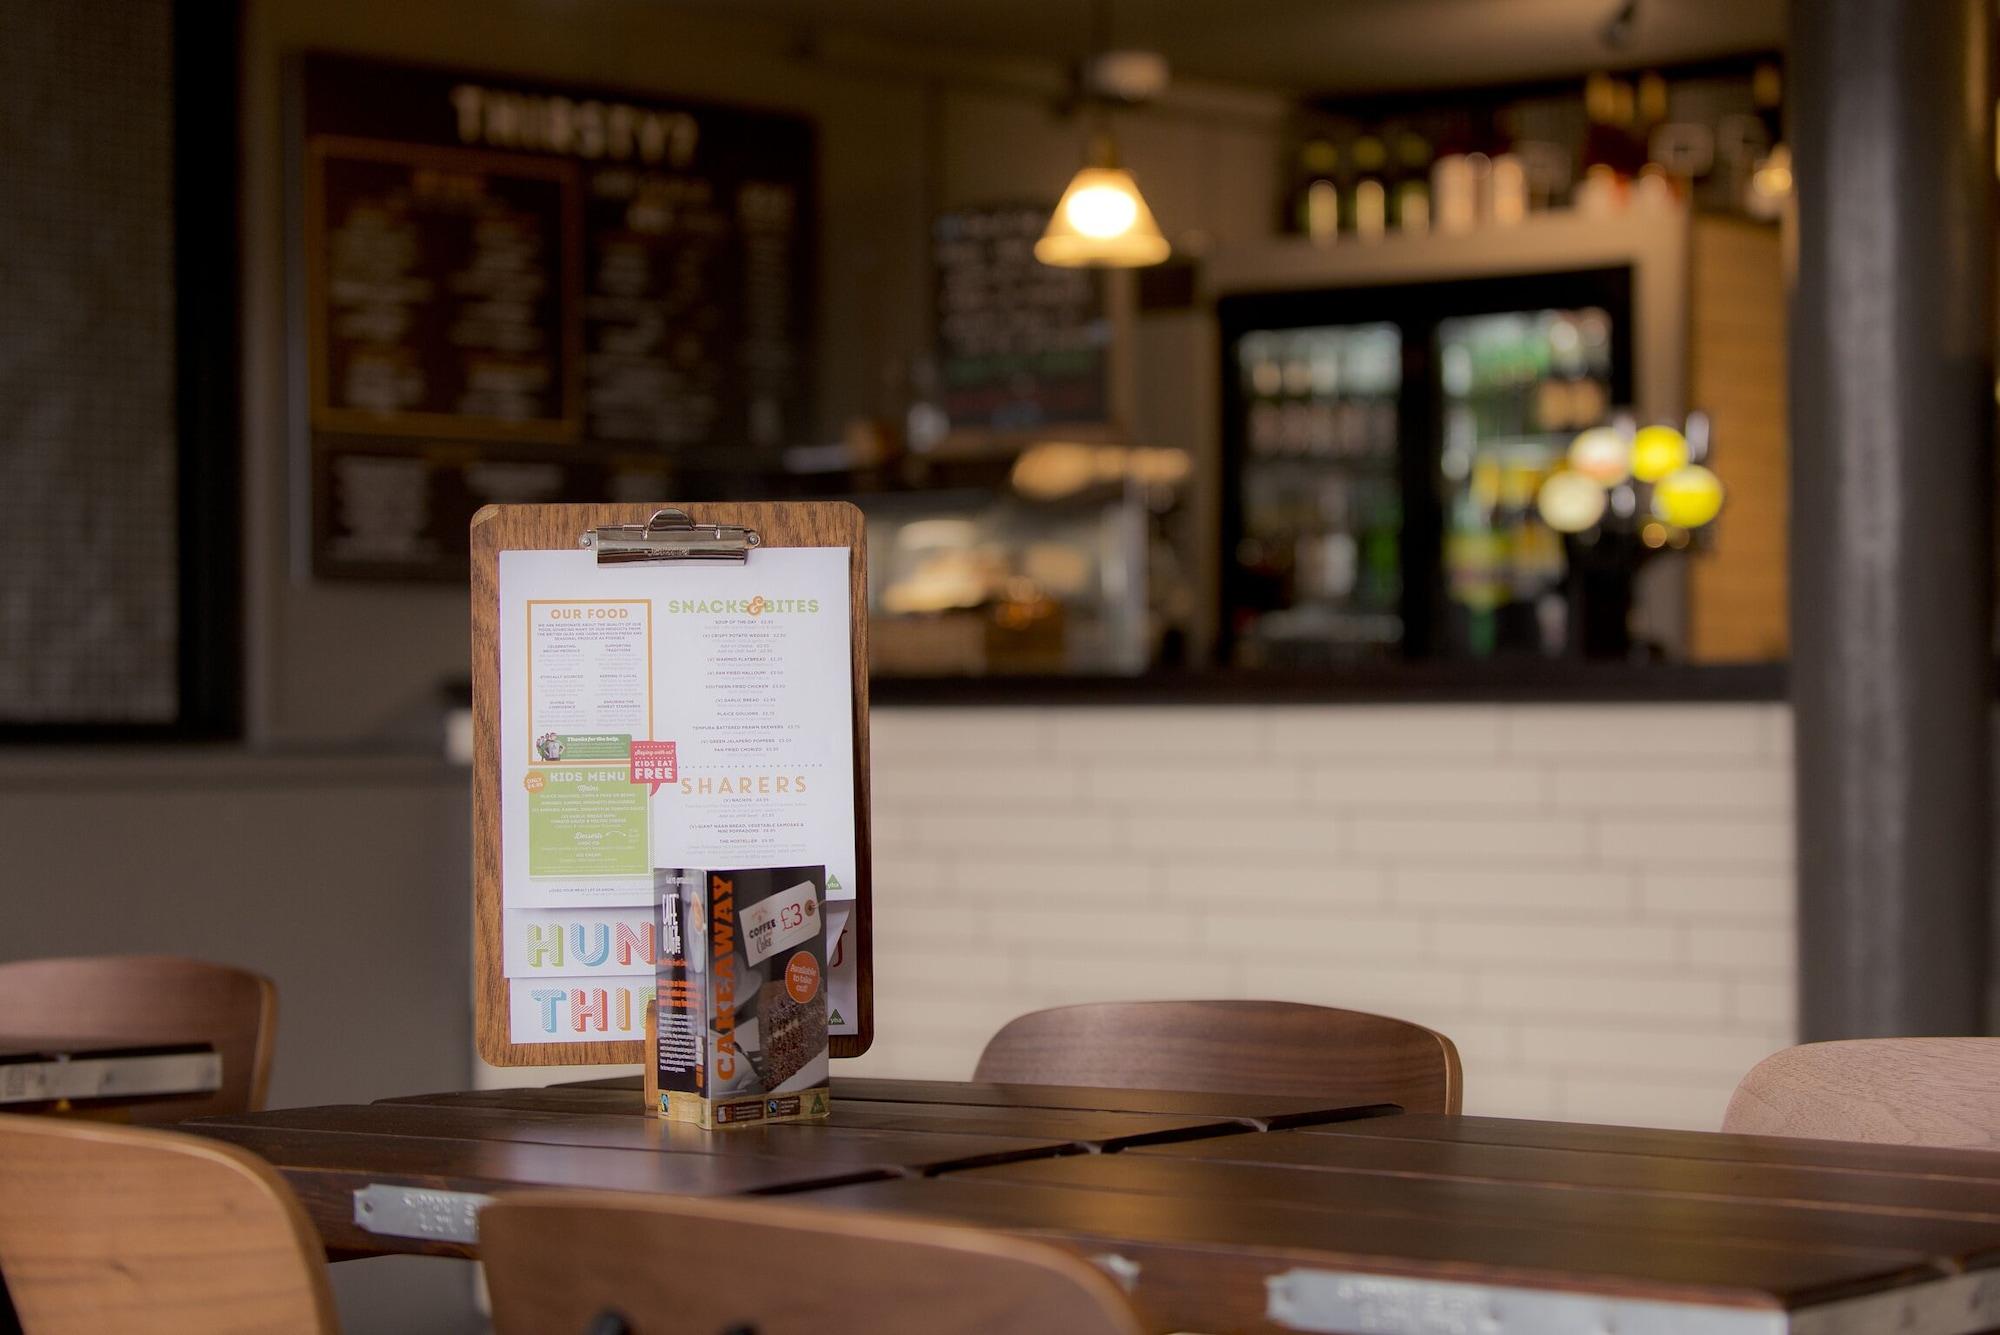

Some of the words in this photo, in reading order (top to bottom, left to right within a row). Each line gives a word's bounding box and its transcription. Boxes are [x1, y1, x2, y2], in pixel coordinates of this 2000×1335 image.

[550, 608, 582, 619] OUR
[587, 608, 628, 619] FOOD
[668, 599, 748, 613] SNACKS
[746, 595, 768, 615] &
[766, 599, 819, 613] BITES
[550, 771, 583, 782] KIDS
[587, 771, 625, 782] MENU
[634, 767, 674, 780] FREE
[681, 776, 807, 794] SHARERS
[779, 903, 802, 930] £3
[748, 919, 775, 939] COFFEE
[712, 875, 735, 1081] CAKEAWAY
